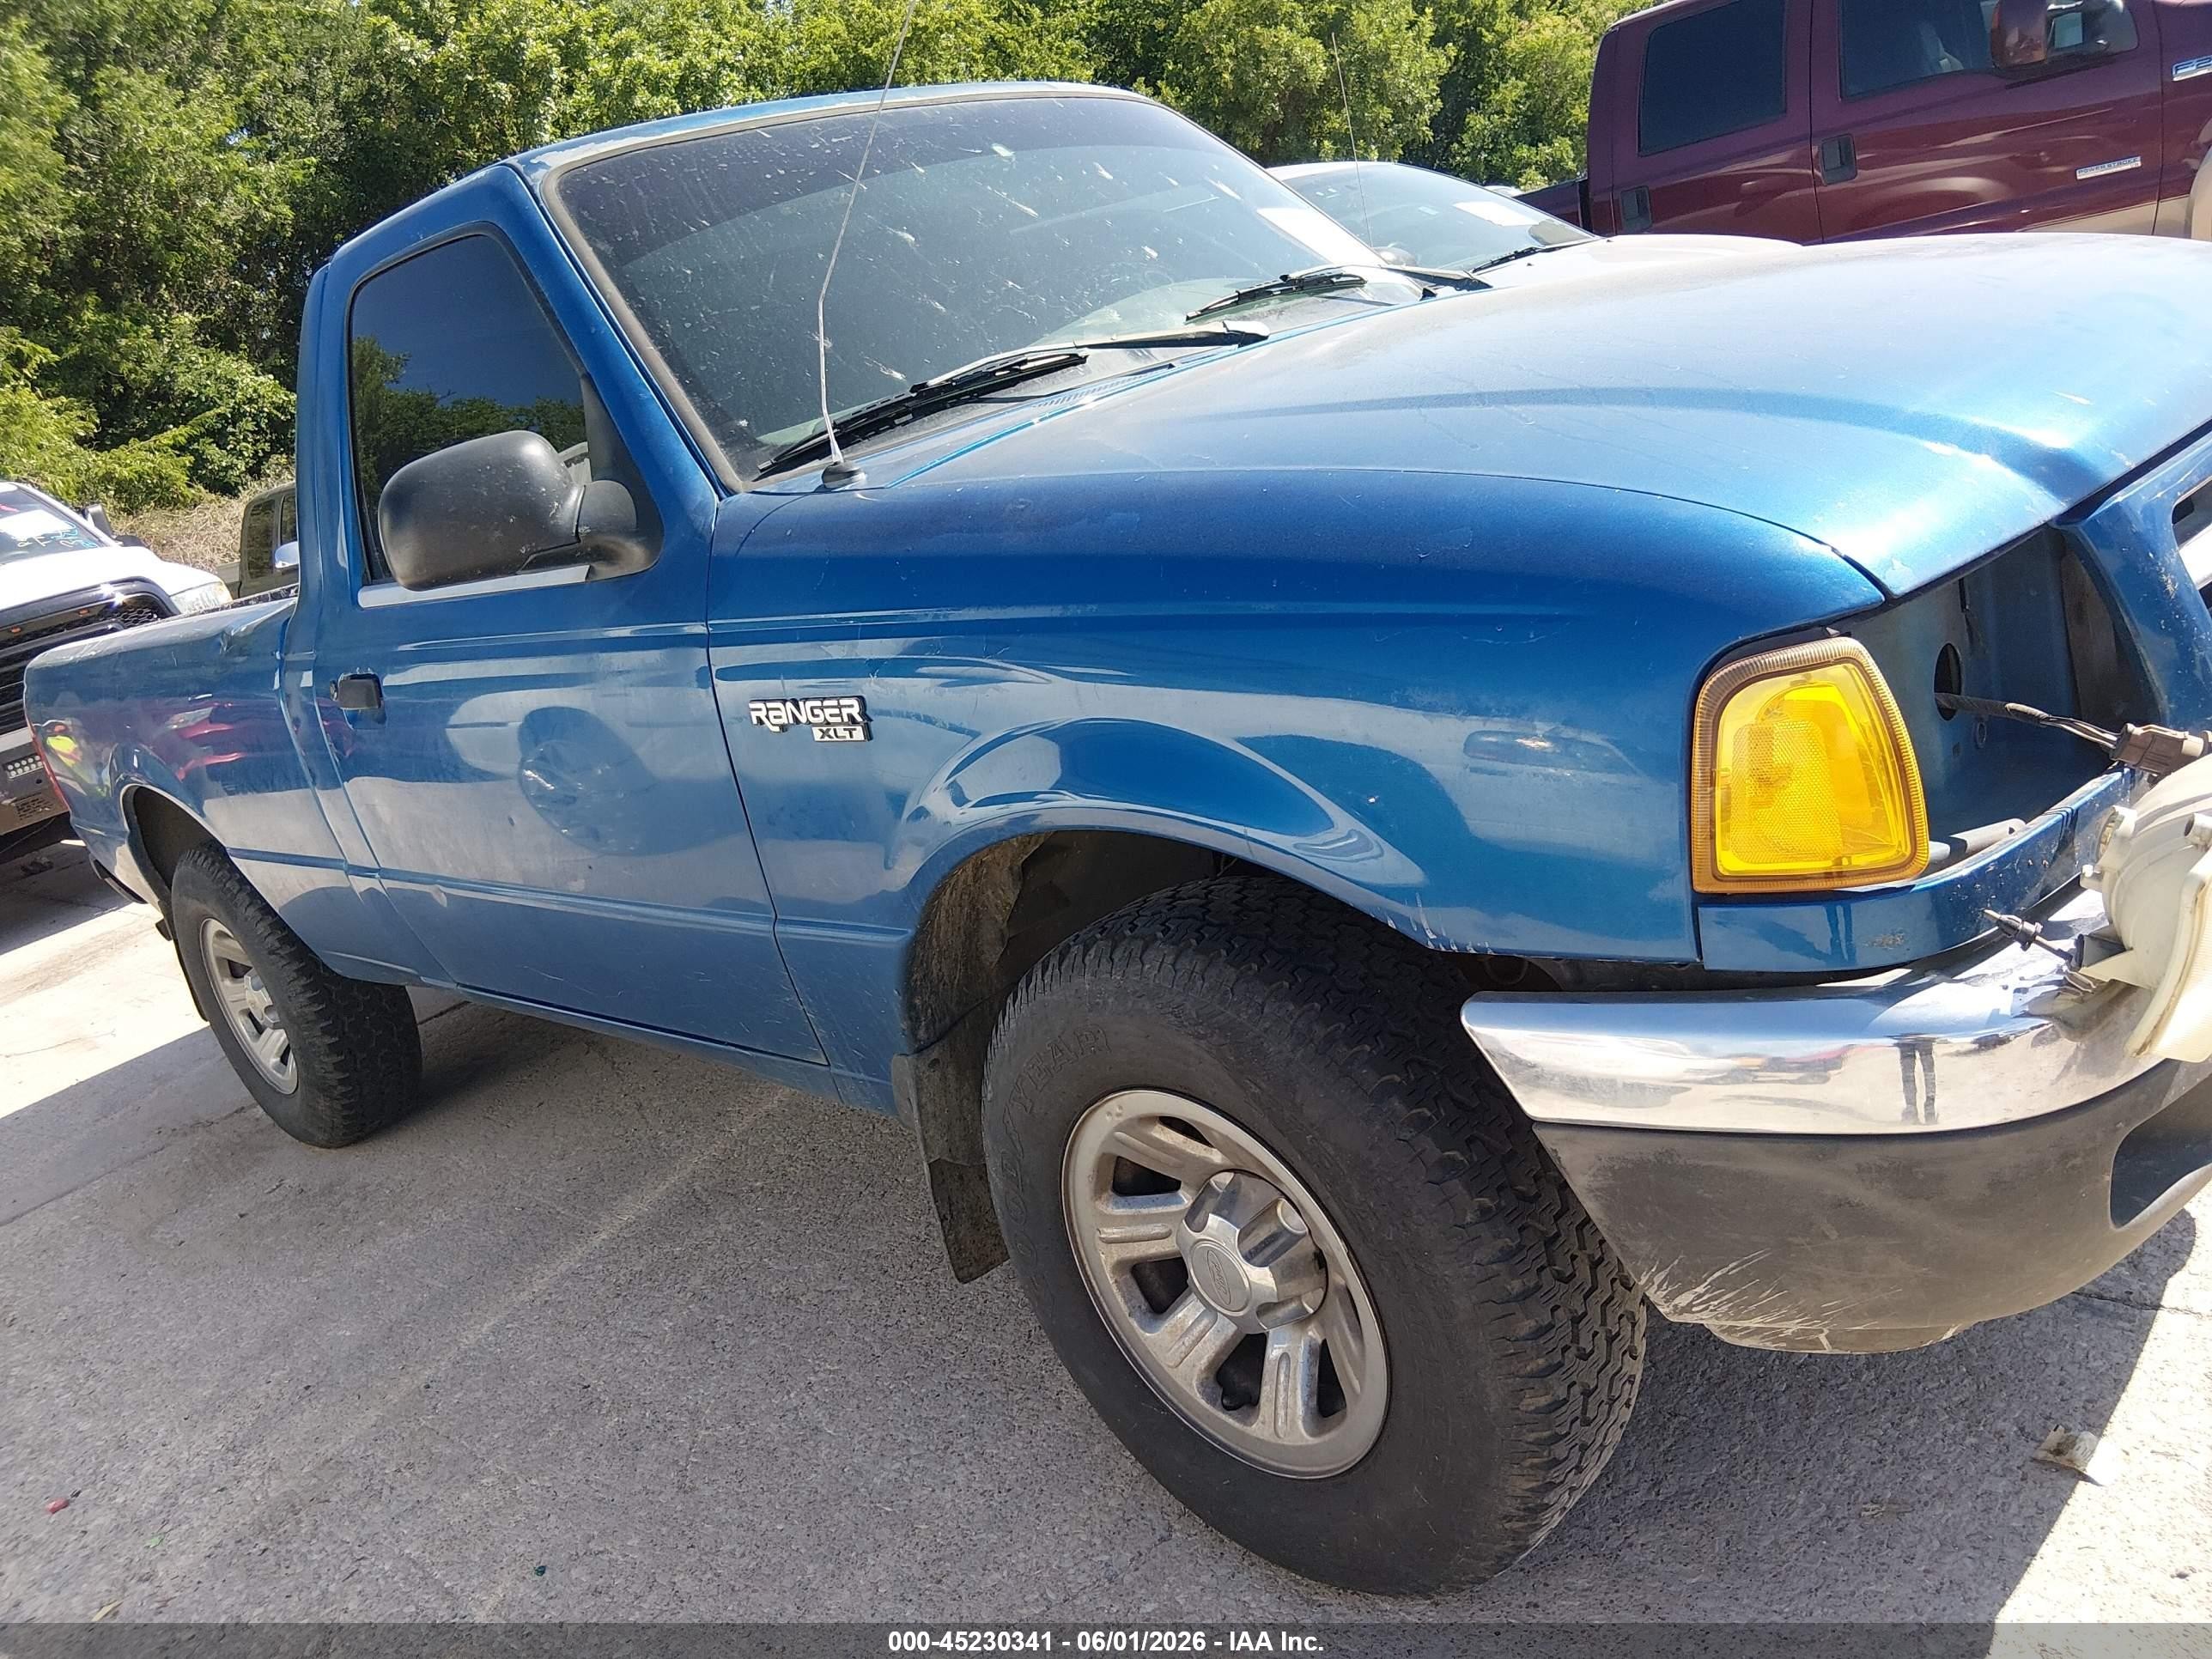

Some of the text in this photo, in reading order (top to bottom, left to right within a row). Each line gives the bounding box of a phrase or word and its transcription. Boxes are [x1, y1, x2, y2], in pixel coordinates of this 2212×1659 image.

[2078, 165, 2106, 174] POWER
[2106, 158, 2139, 168] STROKE
[817, 727, 857, 739] XLT
